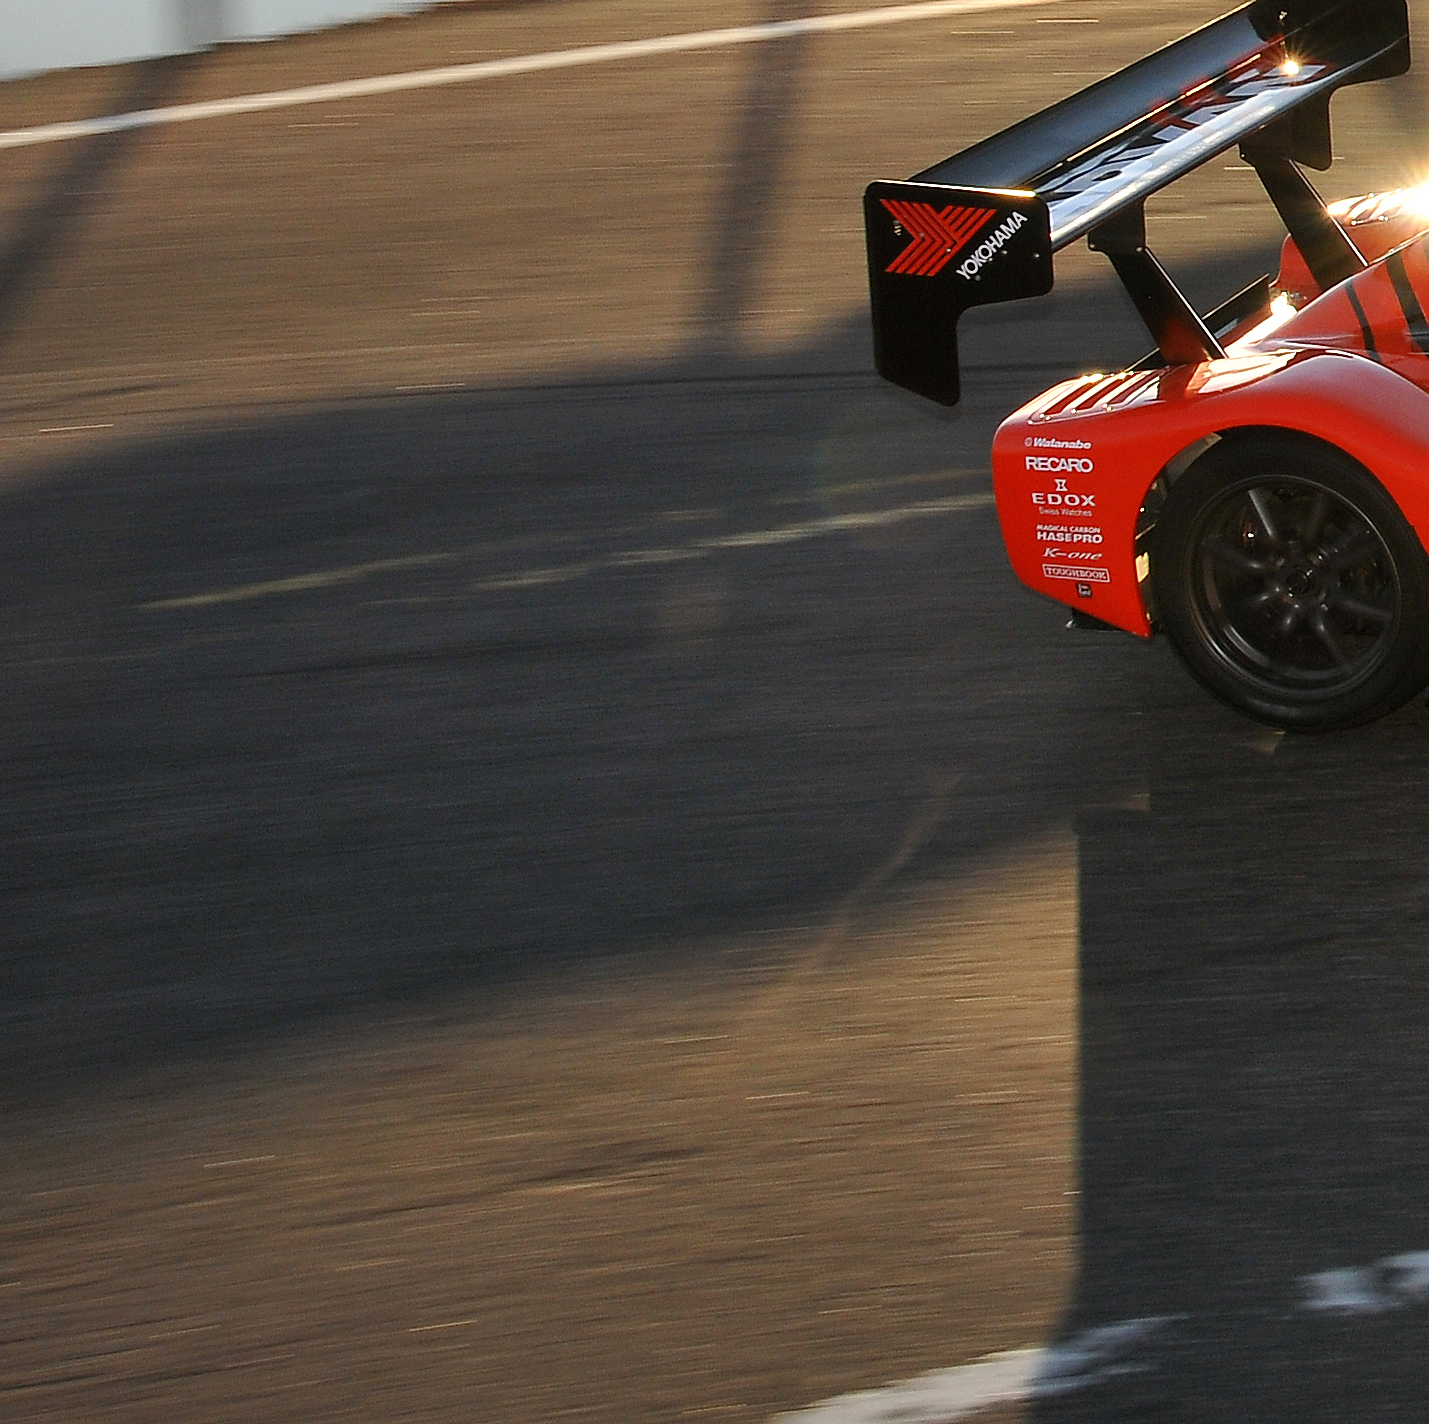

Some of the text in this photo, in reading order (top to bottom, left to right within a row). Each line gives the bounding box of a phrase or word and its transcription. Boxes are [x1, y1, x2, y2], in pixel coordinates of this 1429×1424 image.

[956, 211, 1028, 280] YOKOHAMA
[1025, 456, 1093, 473] RECARO
[1032, 493, 1096, 507] EDOX
[1036, 532, 1103, 544] HASEPRO
[1043, 547, 1103, 561] K-one
